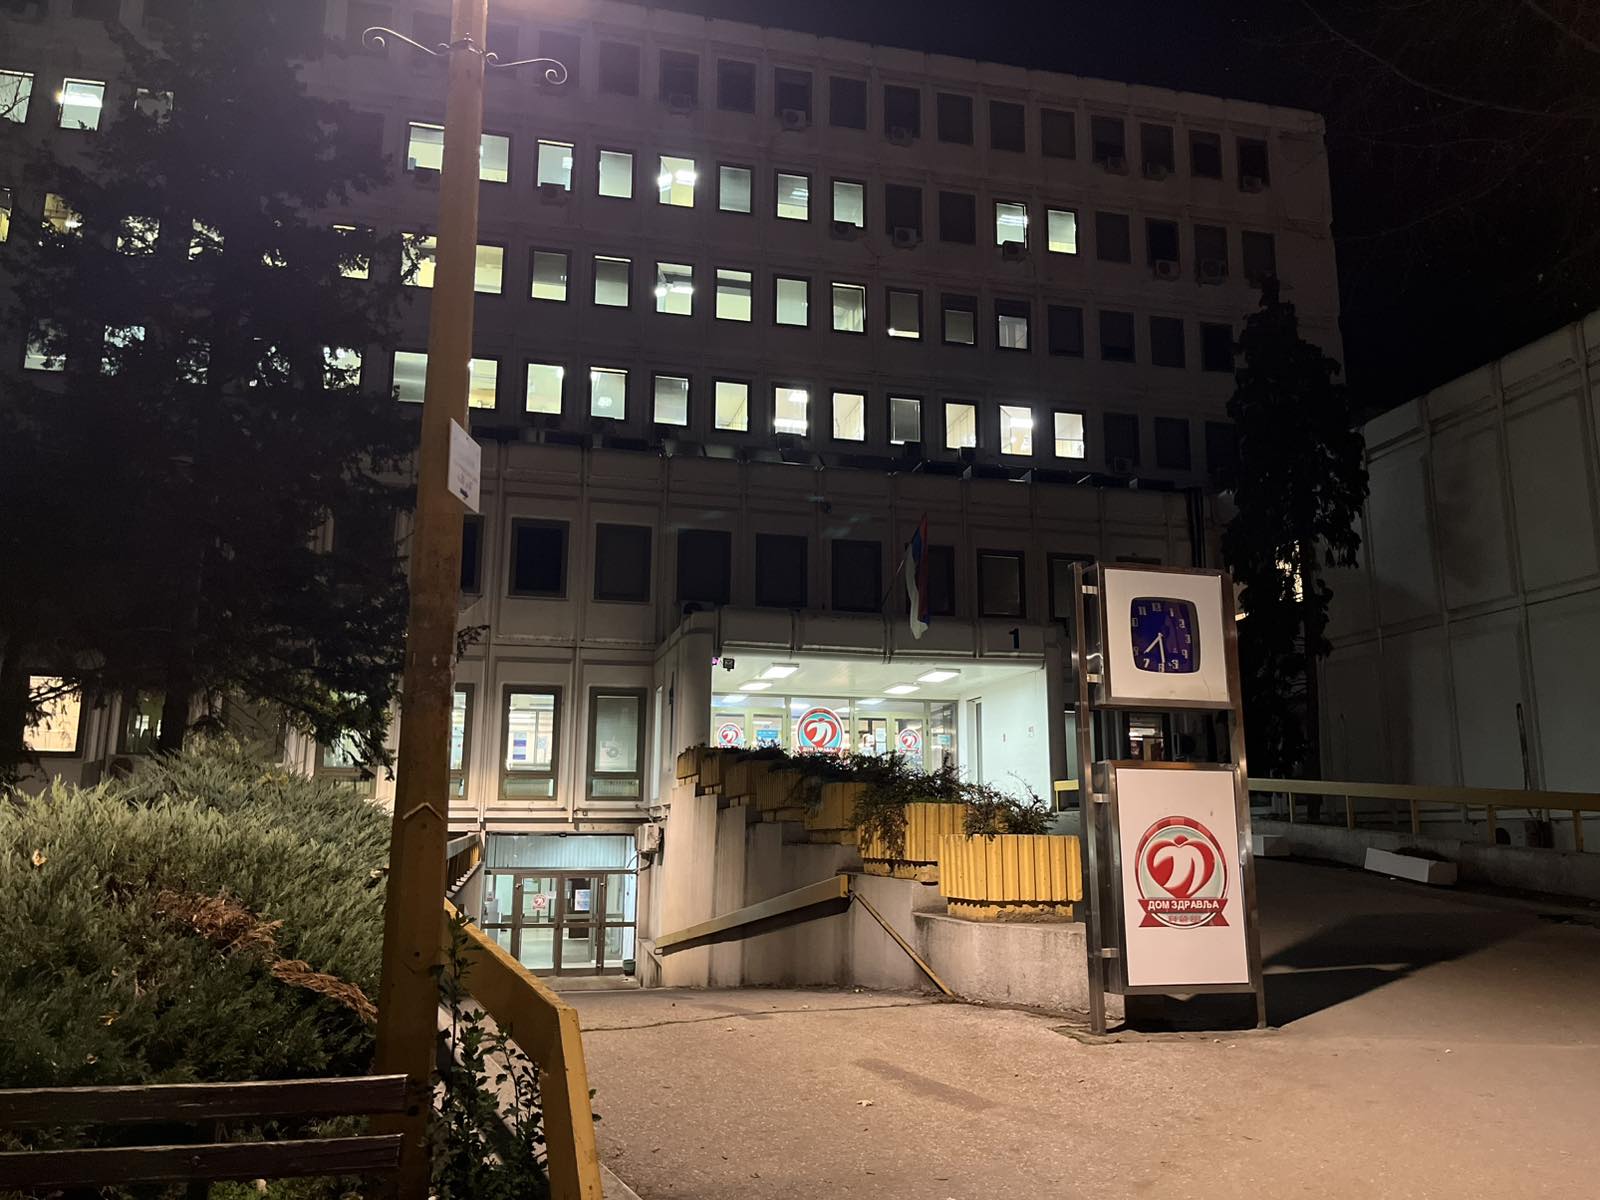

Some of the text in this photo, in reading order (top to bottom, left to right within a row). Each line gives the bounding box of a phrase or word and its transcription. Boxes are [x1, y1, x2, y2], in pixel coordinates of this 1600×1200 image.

[1178, 618, 1186, 629] 2
[1009, 628, 1020, 649] 1
[1143, 658, 1150, 668] 7
[1148, 900, 1219, 911] ДОМ ЗДРАВЉА
